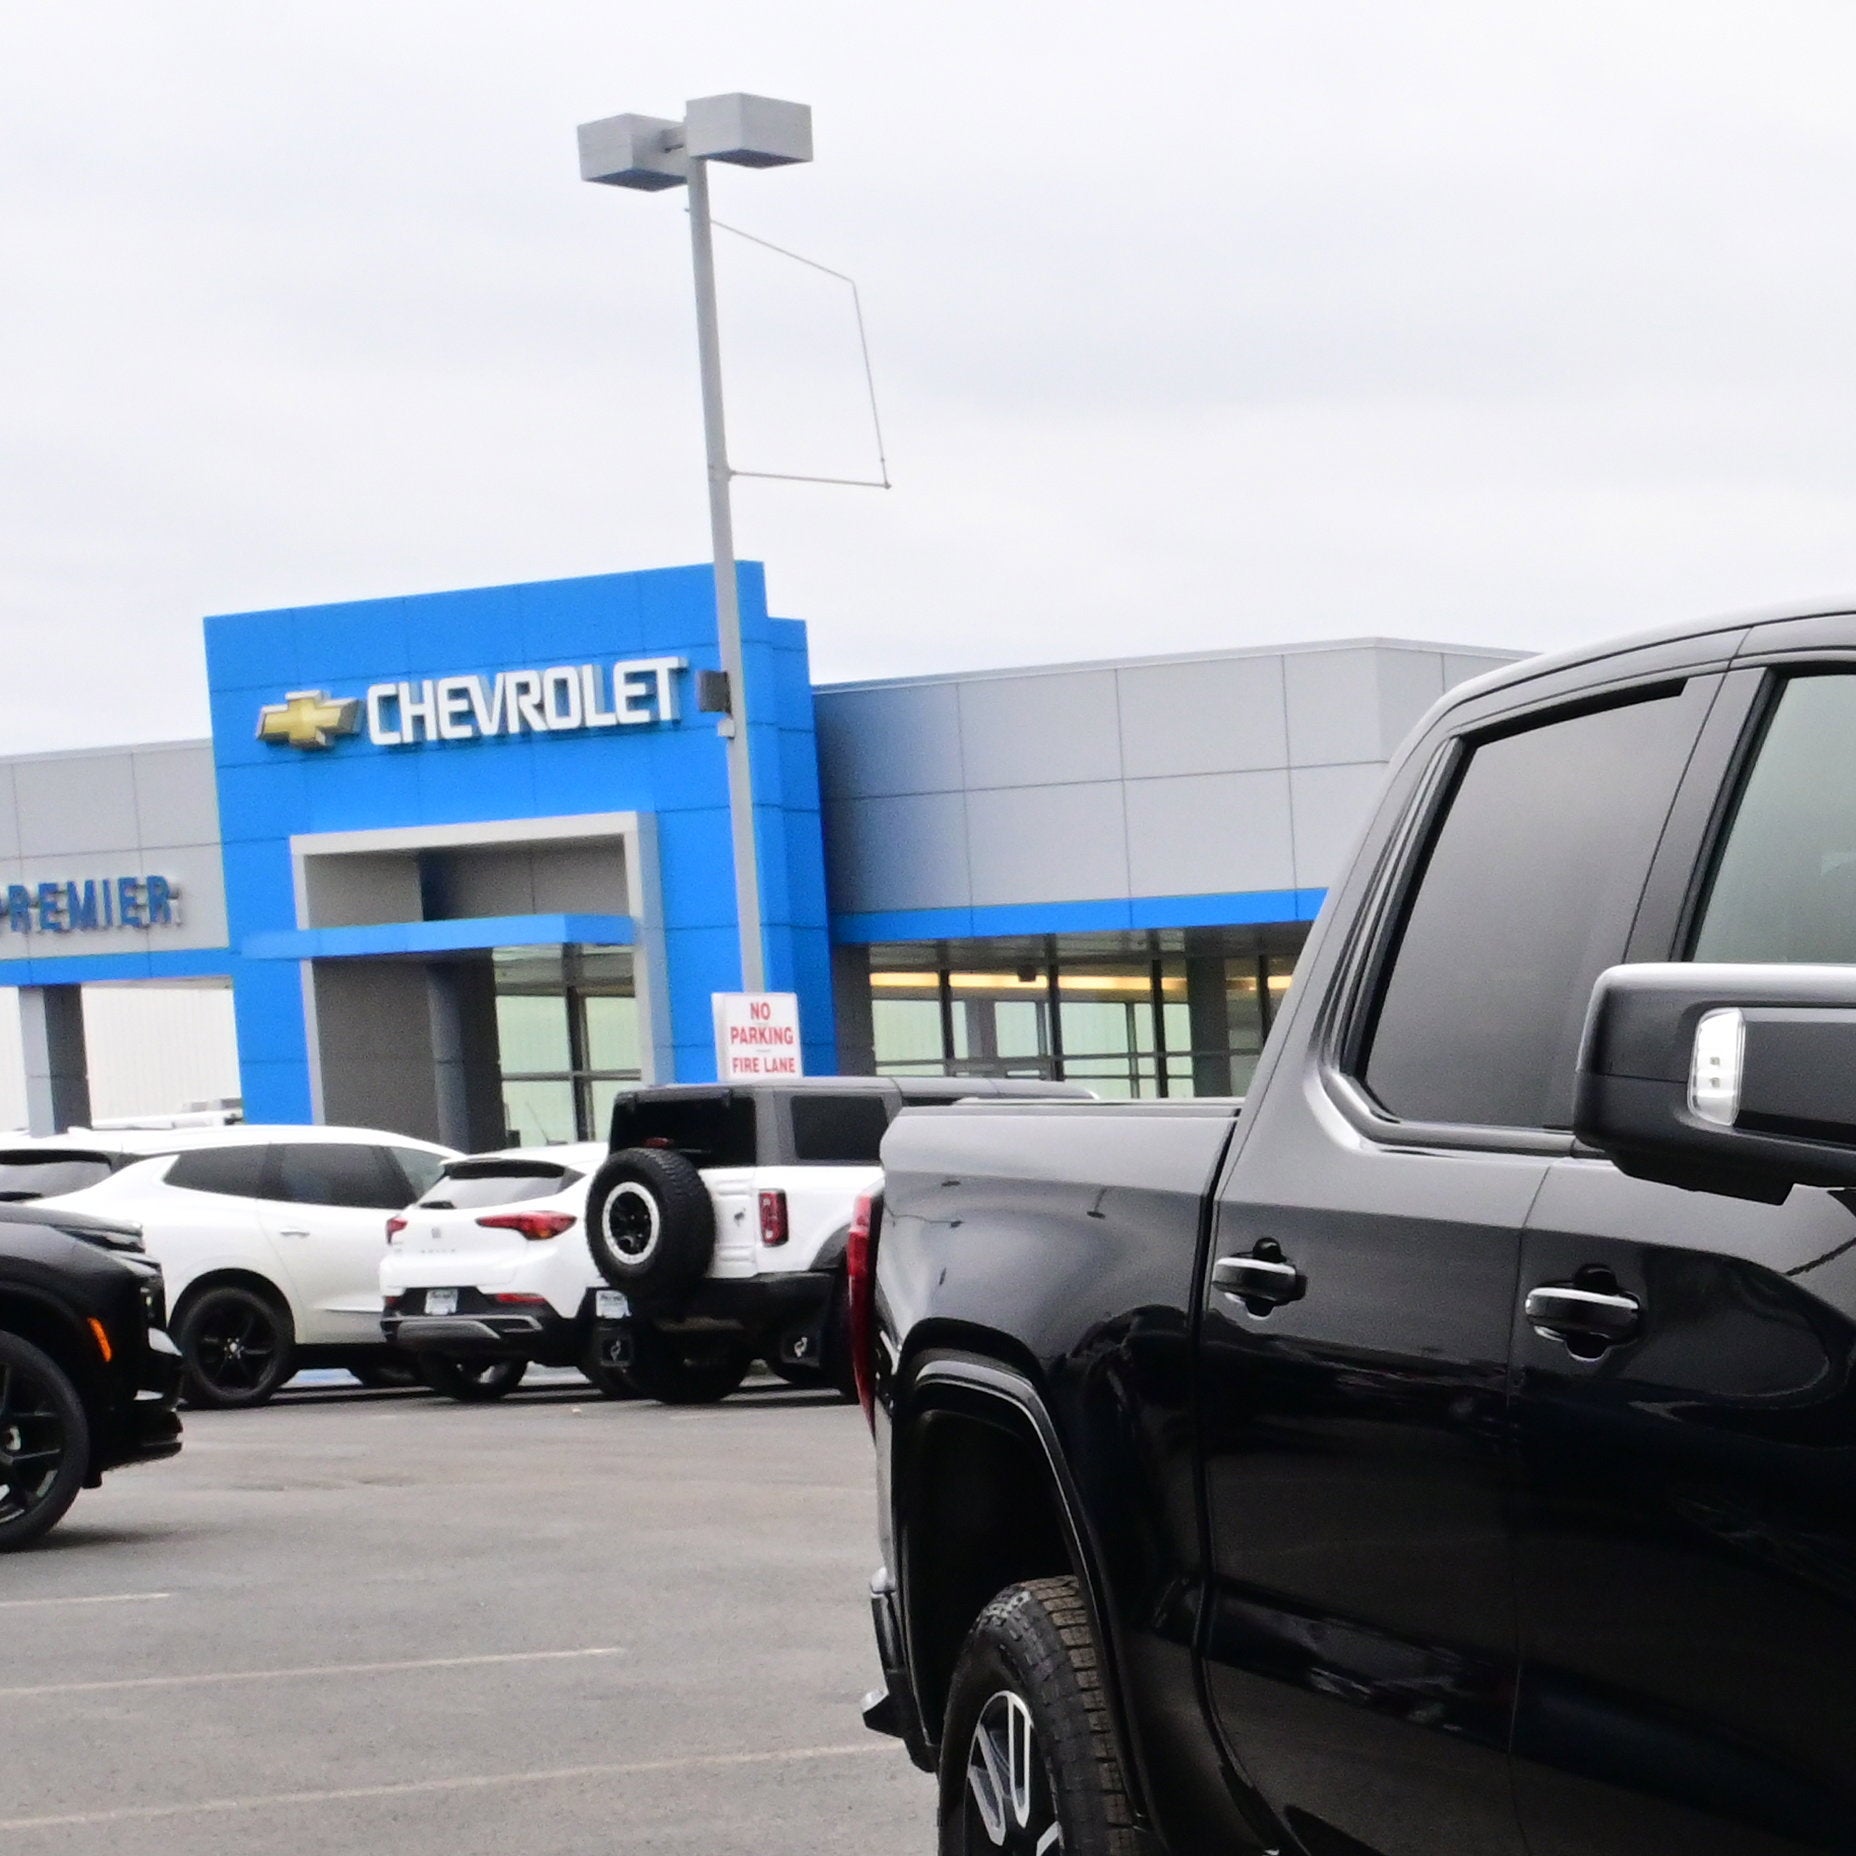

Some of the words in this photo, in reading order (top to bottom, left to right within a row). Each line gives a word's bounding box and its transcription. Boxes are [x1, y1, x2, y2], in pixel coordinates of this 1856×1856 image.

[367, 656, 682, 746] CHEVROLET
[750, 1002, 771, 1020] NO
[730, 1026, 794, 1045] PARKING
[732, 1057, 760, 1073] FIRE
[763, 1057, 796, 1073] LANE
